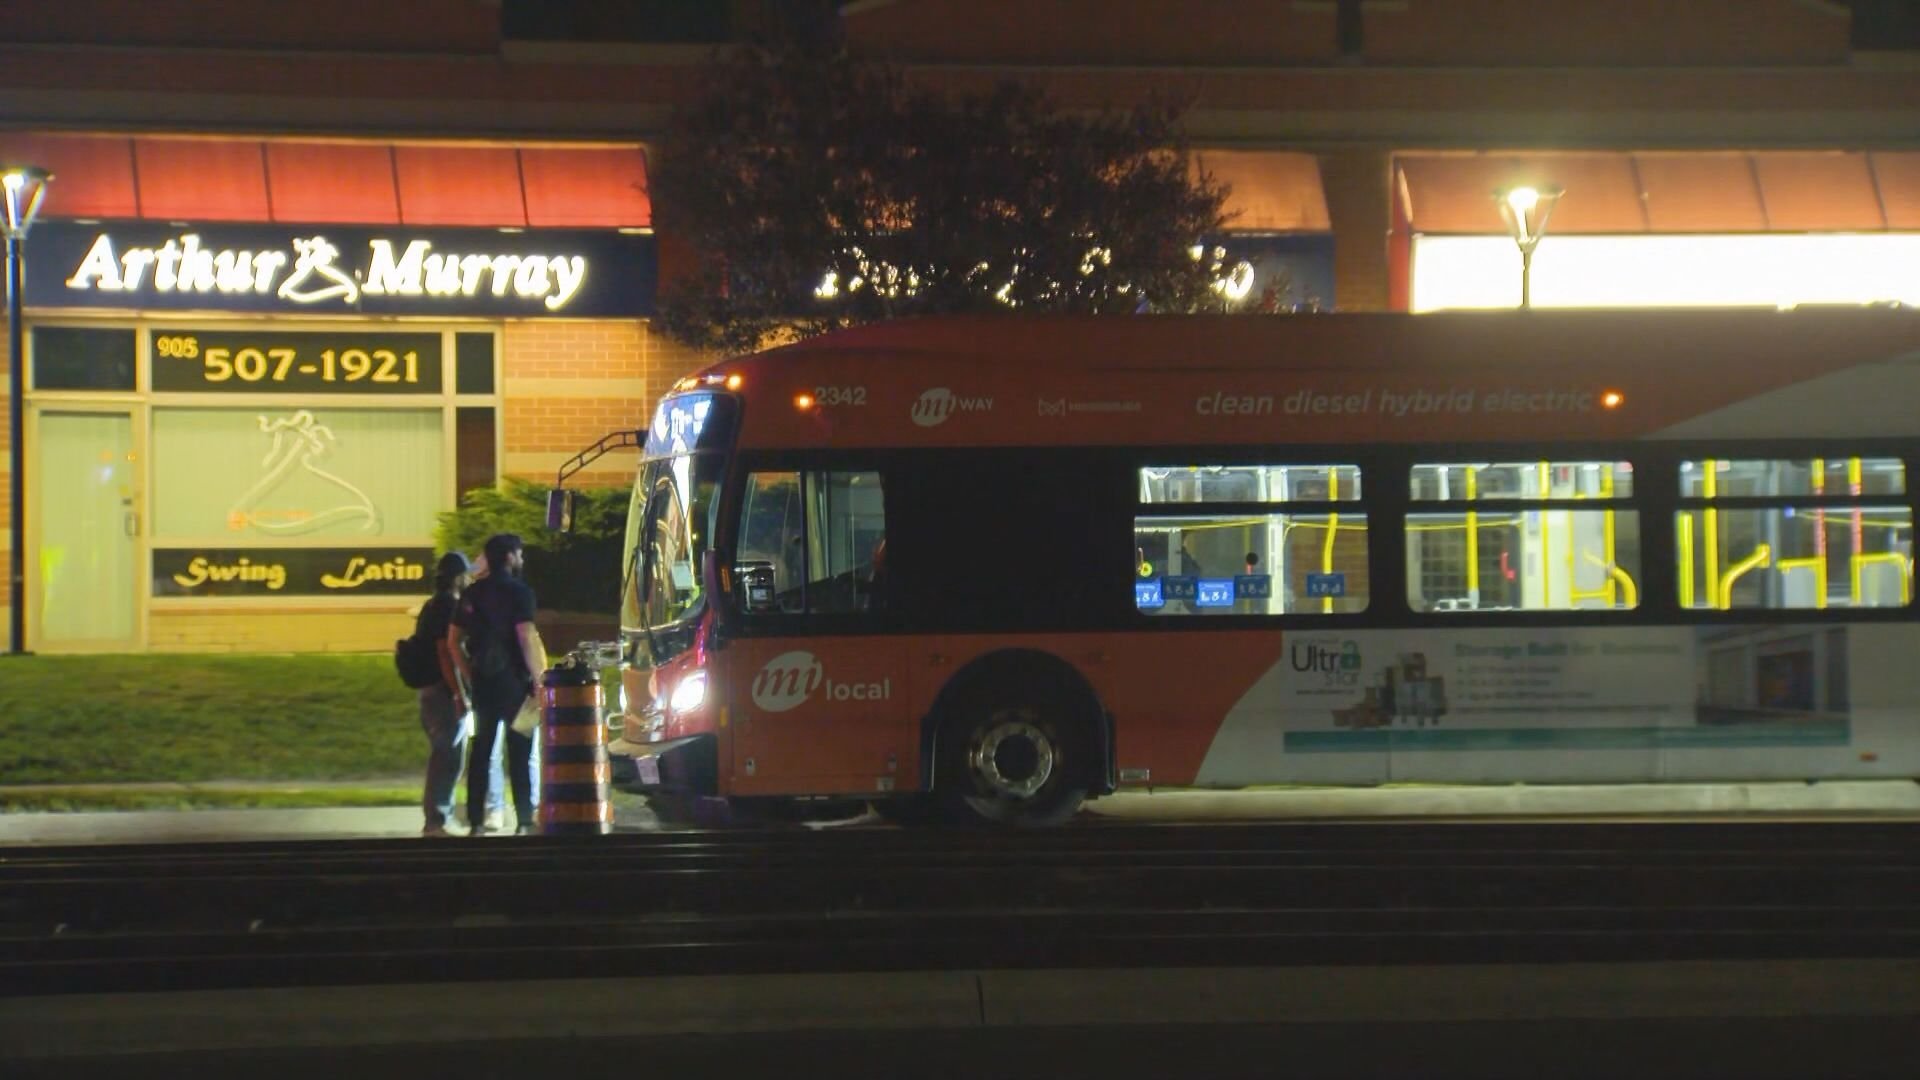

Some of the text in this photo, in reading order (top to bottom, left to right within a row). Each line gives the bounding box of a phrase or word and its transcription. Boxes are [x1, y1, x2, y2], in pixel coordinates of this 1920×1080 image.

[66, 233, 586, 310] Arthur Murray
[157, 337, 419, 383] 905 507-1921
[814, 386, 866, 406] 2342
[959, 396, 994, 412] WAY
[1195, 388, 1592, 417] clean diesel hybrid electric
[174, 557, 424, 590] Swing Latin
[825, 677, 891, 701] local
